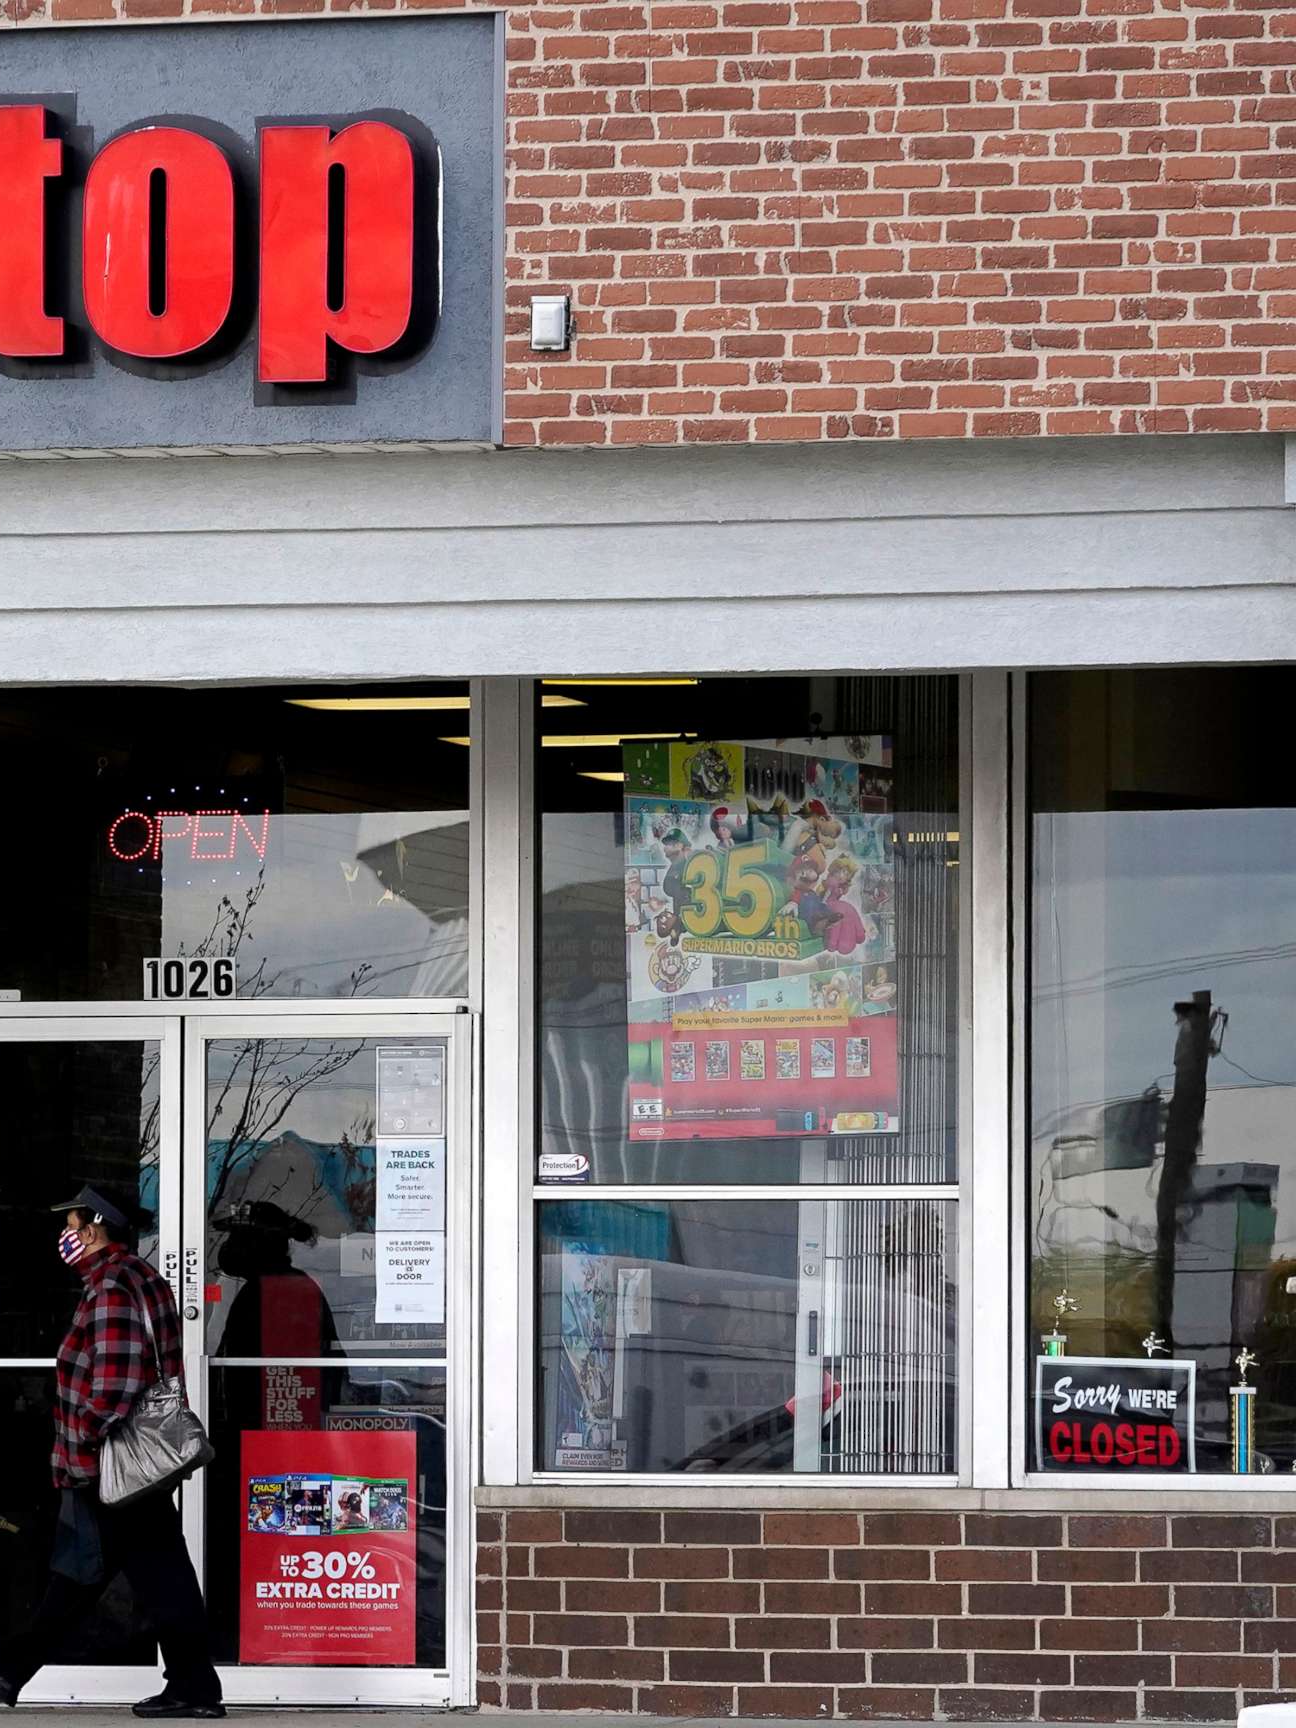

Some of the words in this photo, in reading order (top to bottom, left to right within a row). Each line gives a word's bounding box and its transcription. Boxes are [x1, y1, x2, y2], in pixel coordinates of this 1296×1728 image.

[109, 808, 271, 861] OPEN
[714, 941, 755, 955] MARIO
[146, 959, 233, 999] 1026
[391, 1150, 431, 1159] TRADES
[386, 1161, 406, 1169] ARE
[408, 1161, 436, 1169] BACK
[185, 1250, 198, 1284] PULL
[388, 1258, 431, 1266] DELIVERY
[266, 1366, 296, 1375] GET
[266, 1375, 302, 1387] THIS
[266, 1387, 316, 1399] STUFF
[1052, 1376, 1122, 1415] Sorry
[1127, 1388, 1178, 1410] WE'RE
[266, 1399, 298, 1410] FOR
[266, 1410, 303, 1423] LESS
[329, 1418, 409, 1431] MONOPOLY
[1049, 1421, 1181, 1466] CLOSED
[253, 1483, 282, 1493] CRASH
[280, 1555, 299, 1566] UP
[302, 1551, 376, 1580] 30%
[280, 1566, 299, 1577] TO
[256, 1582, 323, 1599] EXTRA
[326, 1582, 400, 1599] CREDIT
[257, 1601, 278, 1609] when
[279, 1602, 294, 1610] you
[295, 1601, 316, 1609] trade
[317, 1601, 348, 1610] towards
[349, 1601, 371, 1610] these
[372, 1602, 398, 1611] games
